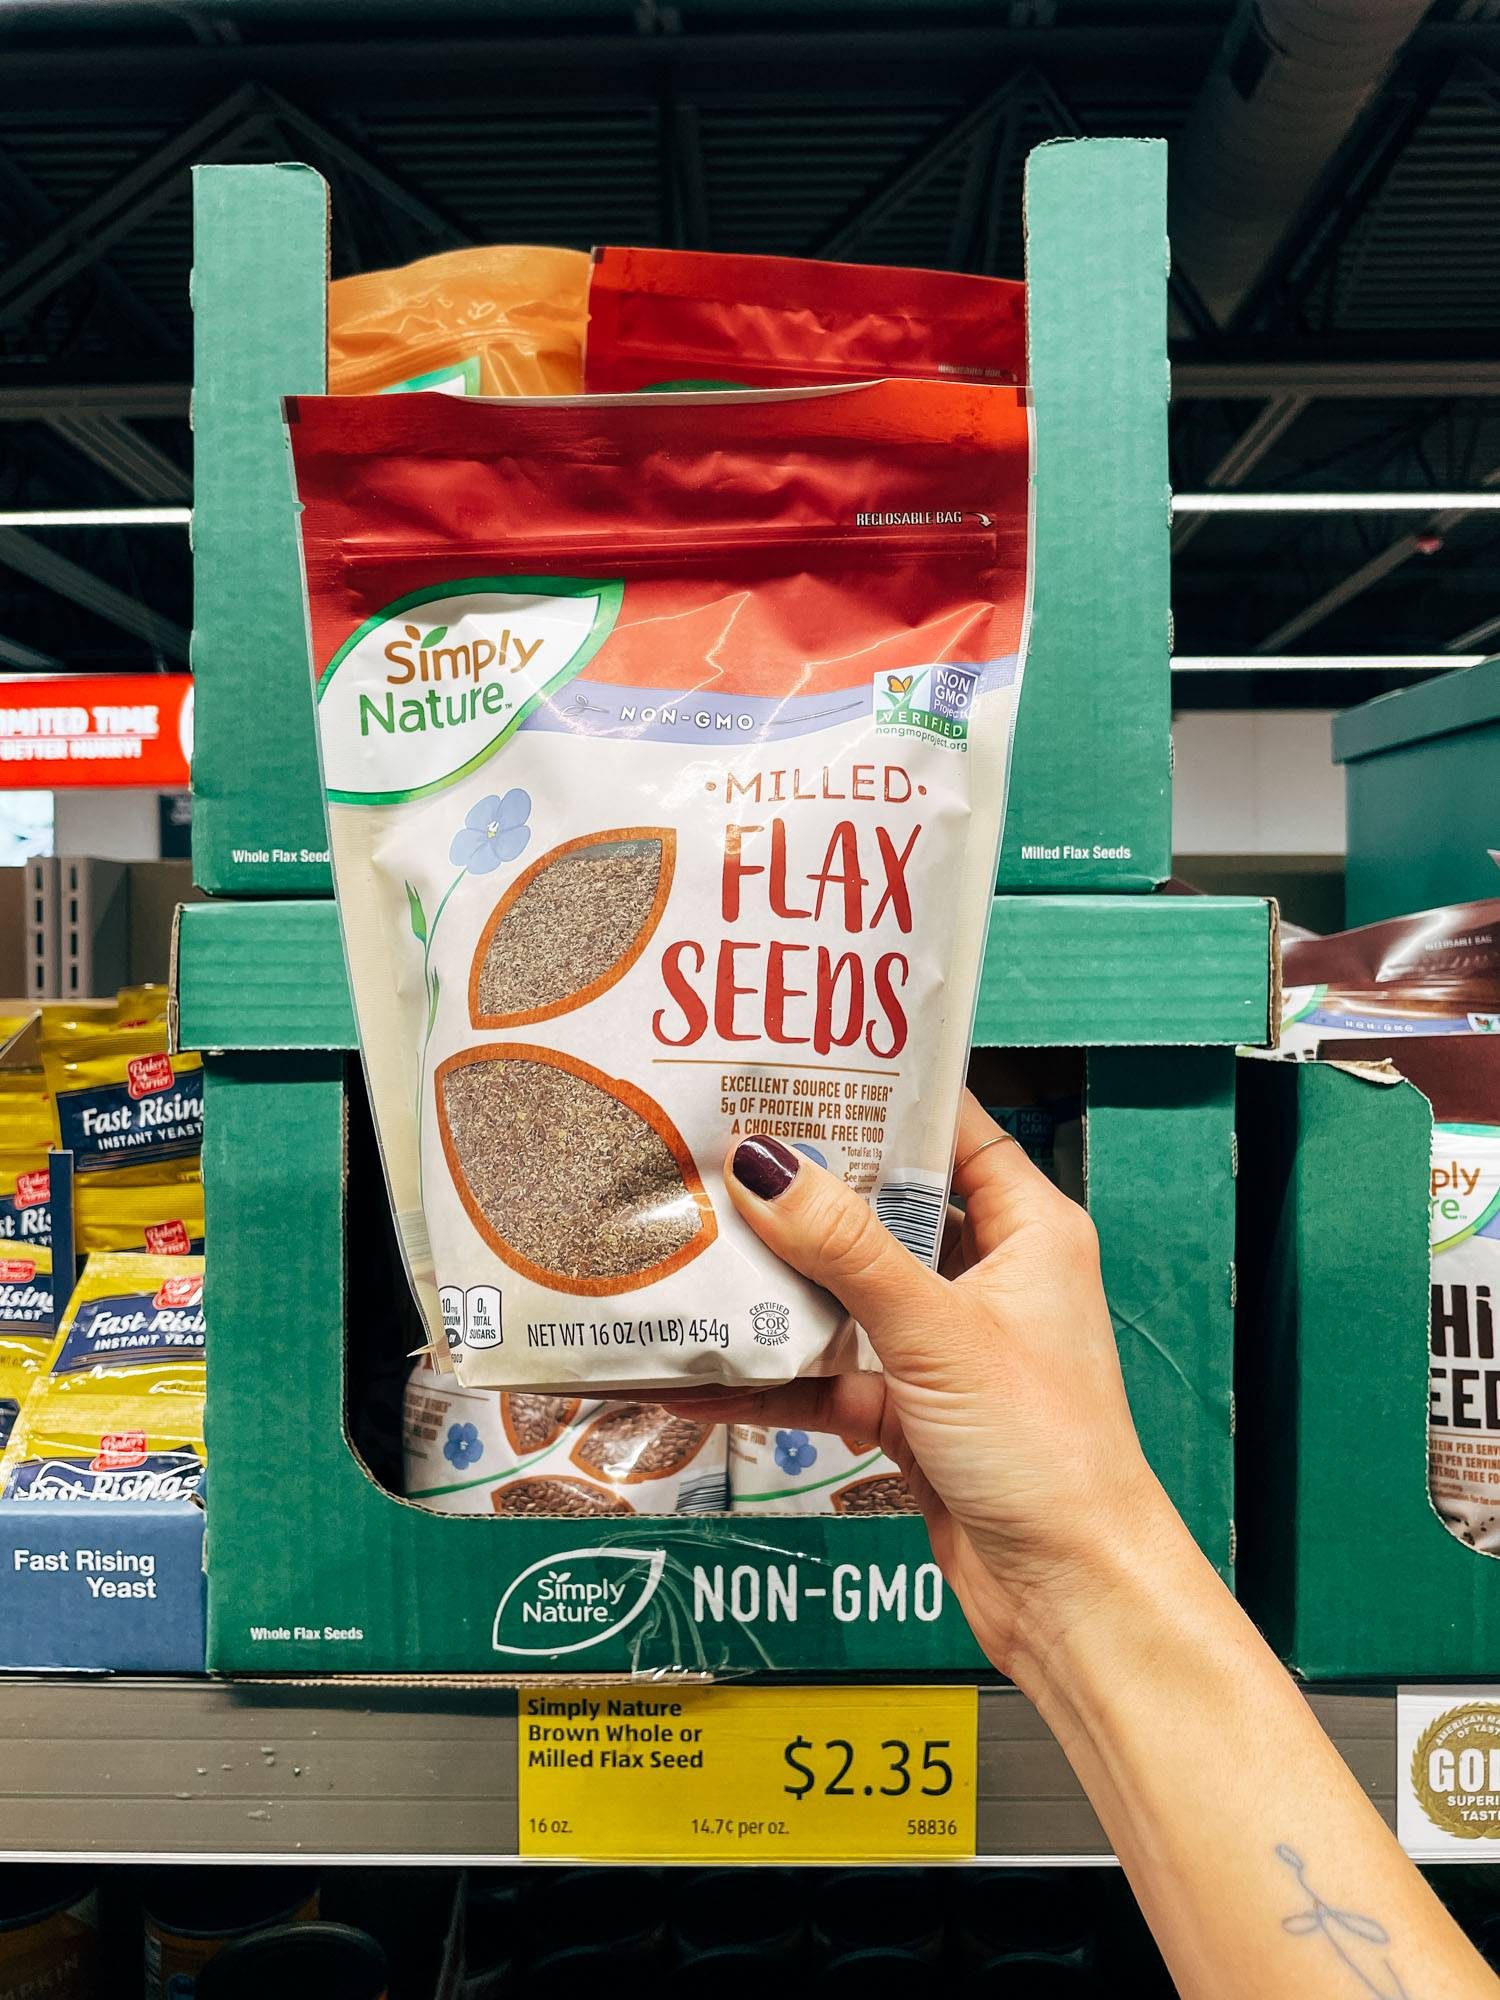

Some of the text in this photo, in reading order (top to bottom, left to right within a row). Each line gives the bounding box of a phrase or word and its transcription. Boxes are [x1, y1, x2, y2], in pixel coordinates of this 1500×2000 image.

[856, 511, 962, 526] RECLOSABLE BAG
[384, 627, 544, 684] Simply
[936, 670, 971, 694] NON
[935, 685, 968, 707] GMO
[359, 682, 505, 736] Nature
[620, 705, 755, 731] NON-GMO
[880, 710, 964, 738] VERIFIED
[726, 765, 911, 804] MILLED
[232, 849, 270, 864] Whole
[272, 849, 298, 864] Flax
[1021, 845, 1132, 860] Milled Flax Seeds
[721, 818, 923, 933] FLAX
[652, 939, 909, 1059] SEEDS
[720, 1075, 790, 1095] EXCELLENT
[793, 1079, 841, 1099] SOURCE
[844, 1083, 858, 1100] OF
[82, 1105, 132, 1136] Fast
[720, 1097, 886, 1122] 5g OF PROTEIN PER SERVING
[98, 1122, 203, 1151] INSTANT YEAST
[731, 1118, 884, 1143] A CHOLESTEROL FREE FOOD
[473, 1315, 492, 1326] TOTAL
[749, 1301, 790, 1316] CERTIFIED
[86, 1311, 150, 1338] Fast
[469, 1328, 496, 1340] SUGARS
[527, 1318, 730, 1349] NET WT 16 OZ (1 LB) 454g
[754, 1316, 787, 1331] COR
[94, 1334, 160, 1350] INSTANT
[754, 1334, 789, 1346] KOSHER
[14, 1549, 156, 1578] Fast Rising
[87, 1576, 157, 1599] Yeast
[537, 1577, 625, 1608] Simply
[694, 1563, 943, 1624] NON-GMO
[523, 1601, 609, 1624] Nature
[250, 1626, 364, 1641] Whole Flax Seeds
[527, 1698, 682, 1721] Simply Nature
[528, 1724, 703, 1742] Brown Whole or
[1457, 1727, 1470, 1739] OF
[528, 1750, 703, 1769] Milled Flax Seed
[783, 1735, 953, 1800] $2.35
[530, 1818, 957, 1838] 16 oz. 14.7¢ per oz. 58836
